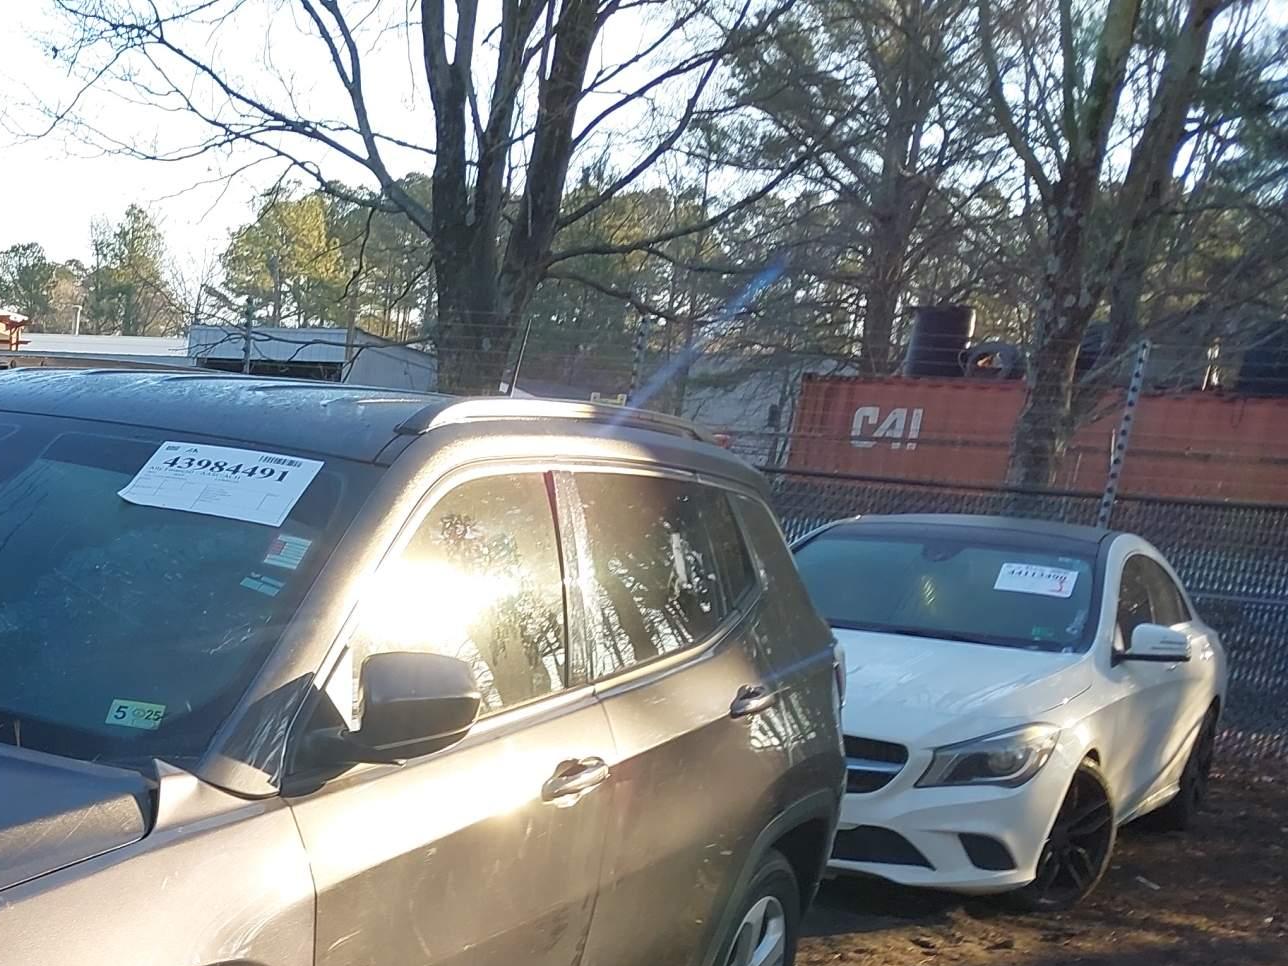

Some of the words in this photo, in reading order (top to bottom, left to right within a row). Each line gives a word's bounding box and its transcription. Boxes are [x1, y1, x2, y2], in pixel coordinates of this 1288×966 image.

[850, 406, 924, 450] CAI
[163, 455, 290, 483] 43984491
[114, 705, 128, 720] 5
[145, 709, 162, 722] 25
